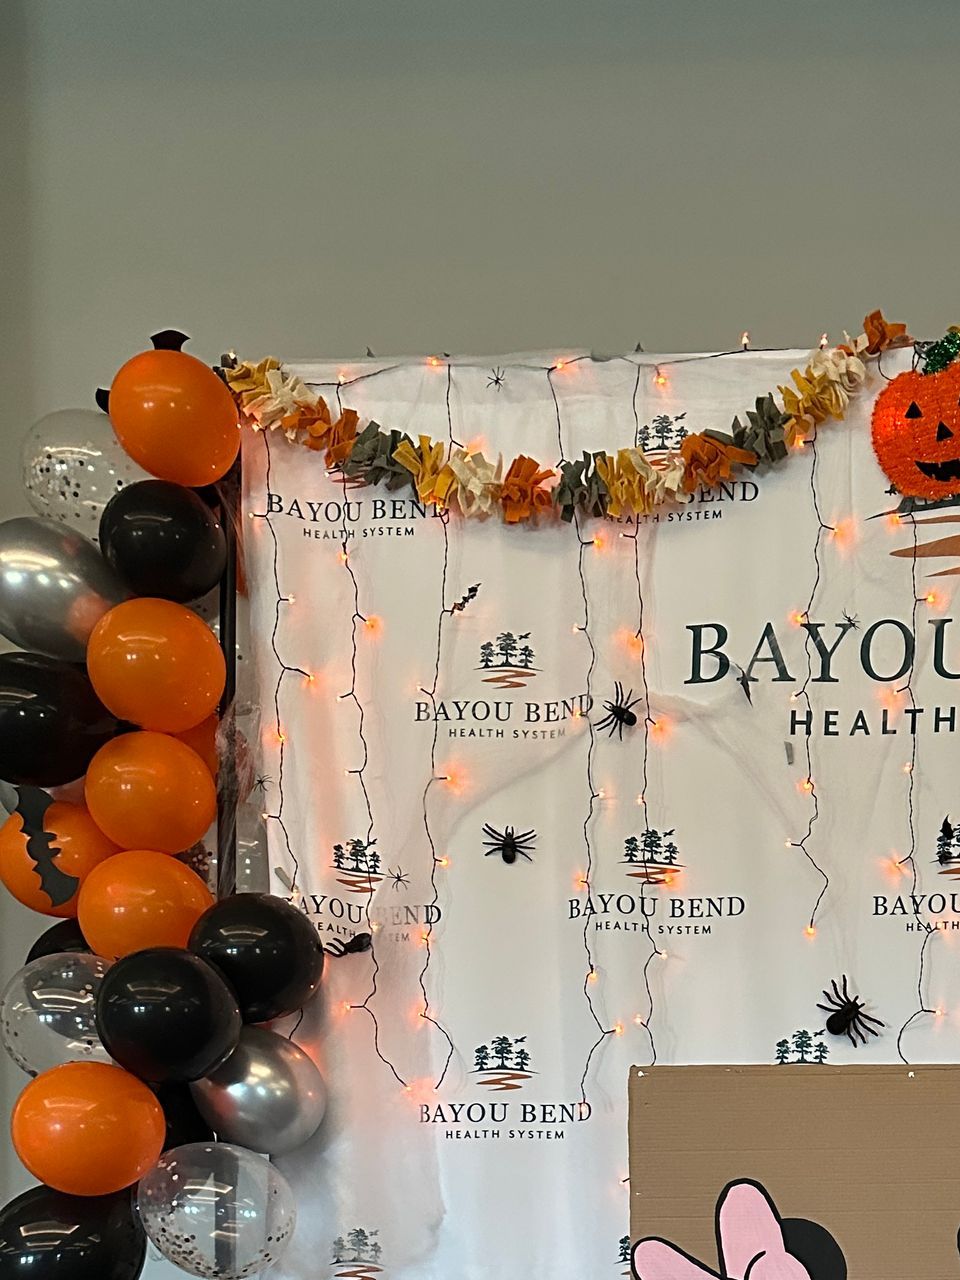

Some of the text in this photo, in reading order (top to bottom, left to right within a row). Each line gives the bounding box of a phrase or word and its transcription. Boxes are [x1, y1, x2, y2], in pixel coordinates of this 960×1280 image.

[679, 481, 759, 504] END
[268, 494, 363, 522] BAYOU
[668, 510, 722, 522] SYSTEM
[303, 527, 414, 539] HEALTH SYSTEM
[414, 694, 593, 722] BAYOU BEND
[790, 706, 956, 736] HEALTH
[449, 728, 566, 739] HEALTH SYSTEM
[285, 895, 442, 926] AYOU END
[569, 894, 745, 919] BAYOU BEND
[595, 921, 712, 934] HEALTH SYSTEM
[906, 921, 960, 932] HEALTH
[419, 1102, 591, 1123] BAYOU BEND
[446, 1130, 564, 1139] HEALTH SYSTEM
